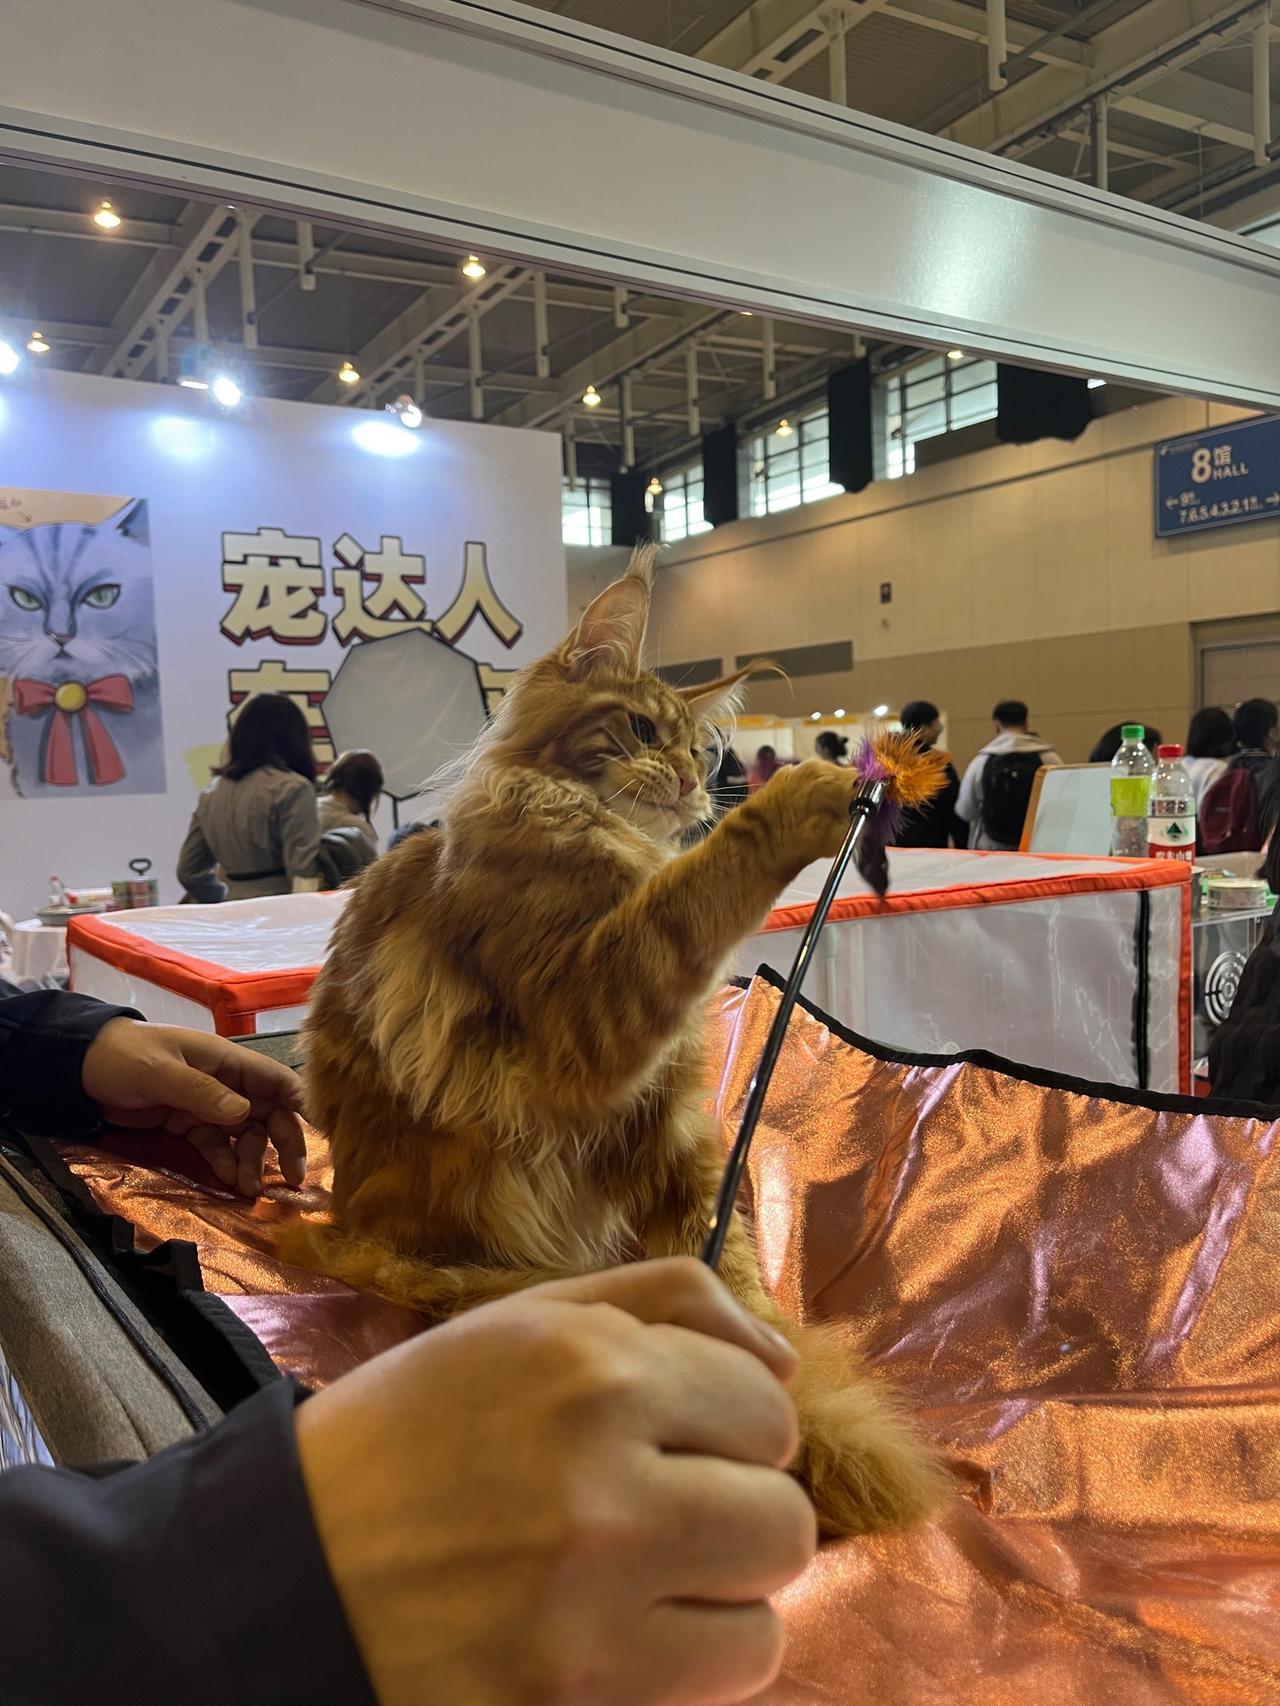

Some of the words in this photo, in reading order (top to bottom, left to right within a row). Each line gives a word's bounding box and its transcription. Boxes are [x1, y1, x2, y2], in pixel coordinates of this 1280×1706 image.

[1212, 462, 1249, 480] HALL
[220, 527, 523, 649] 宠达人
